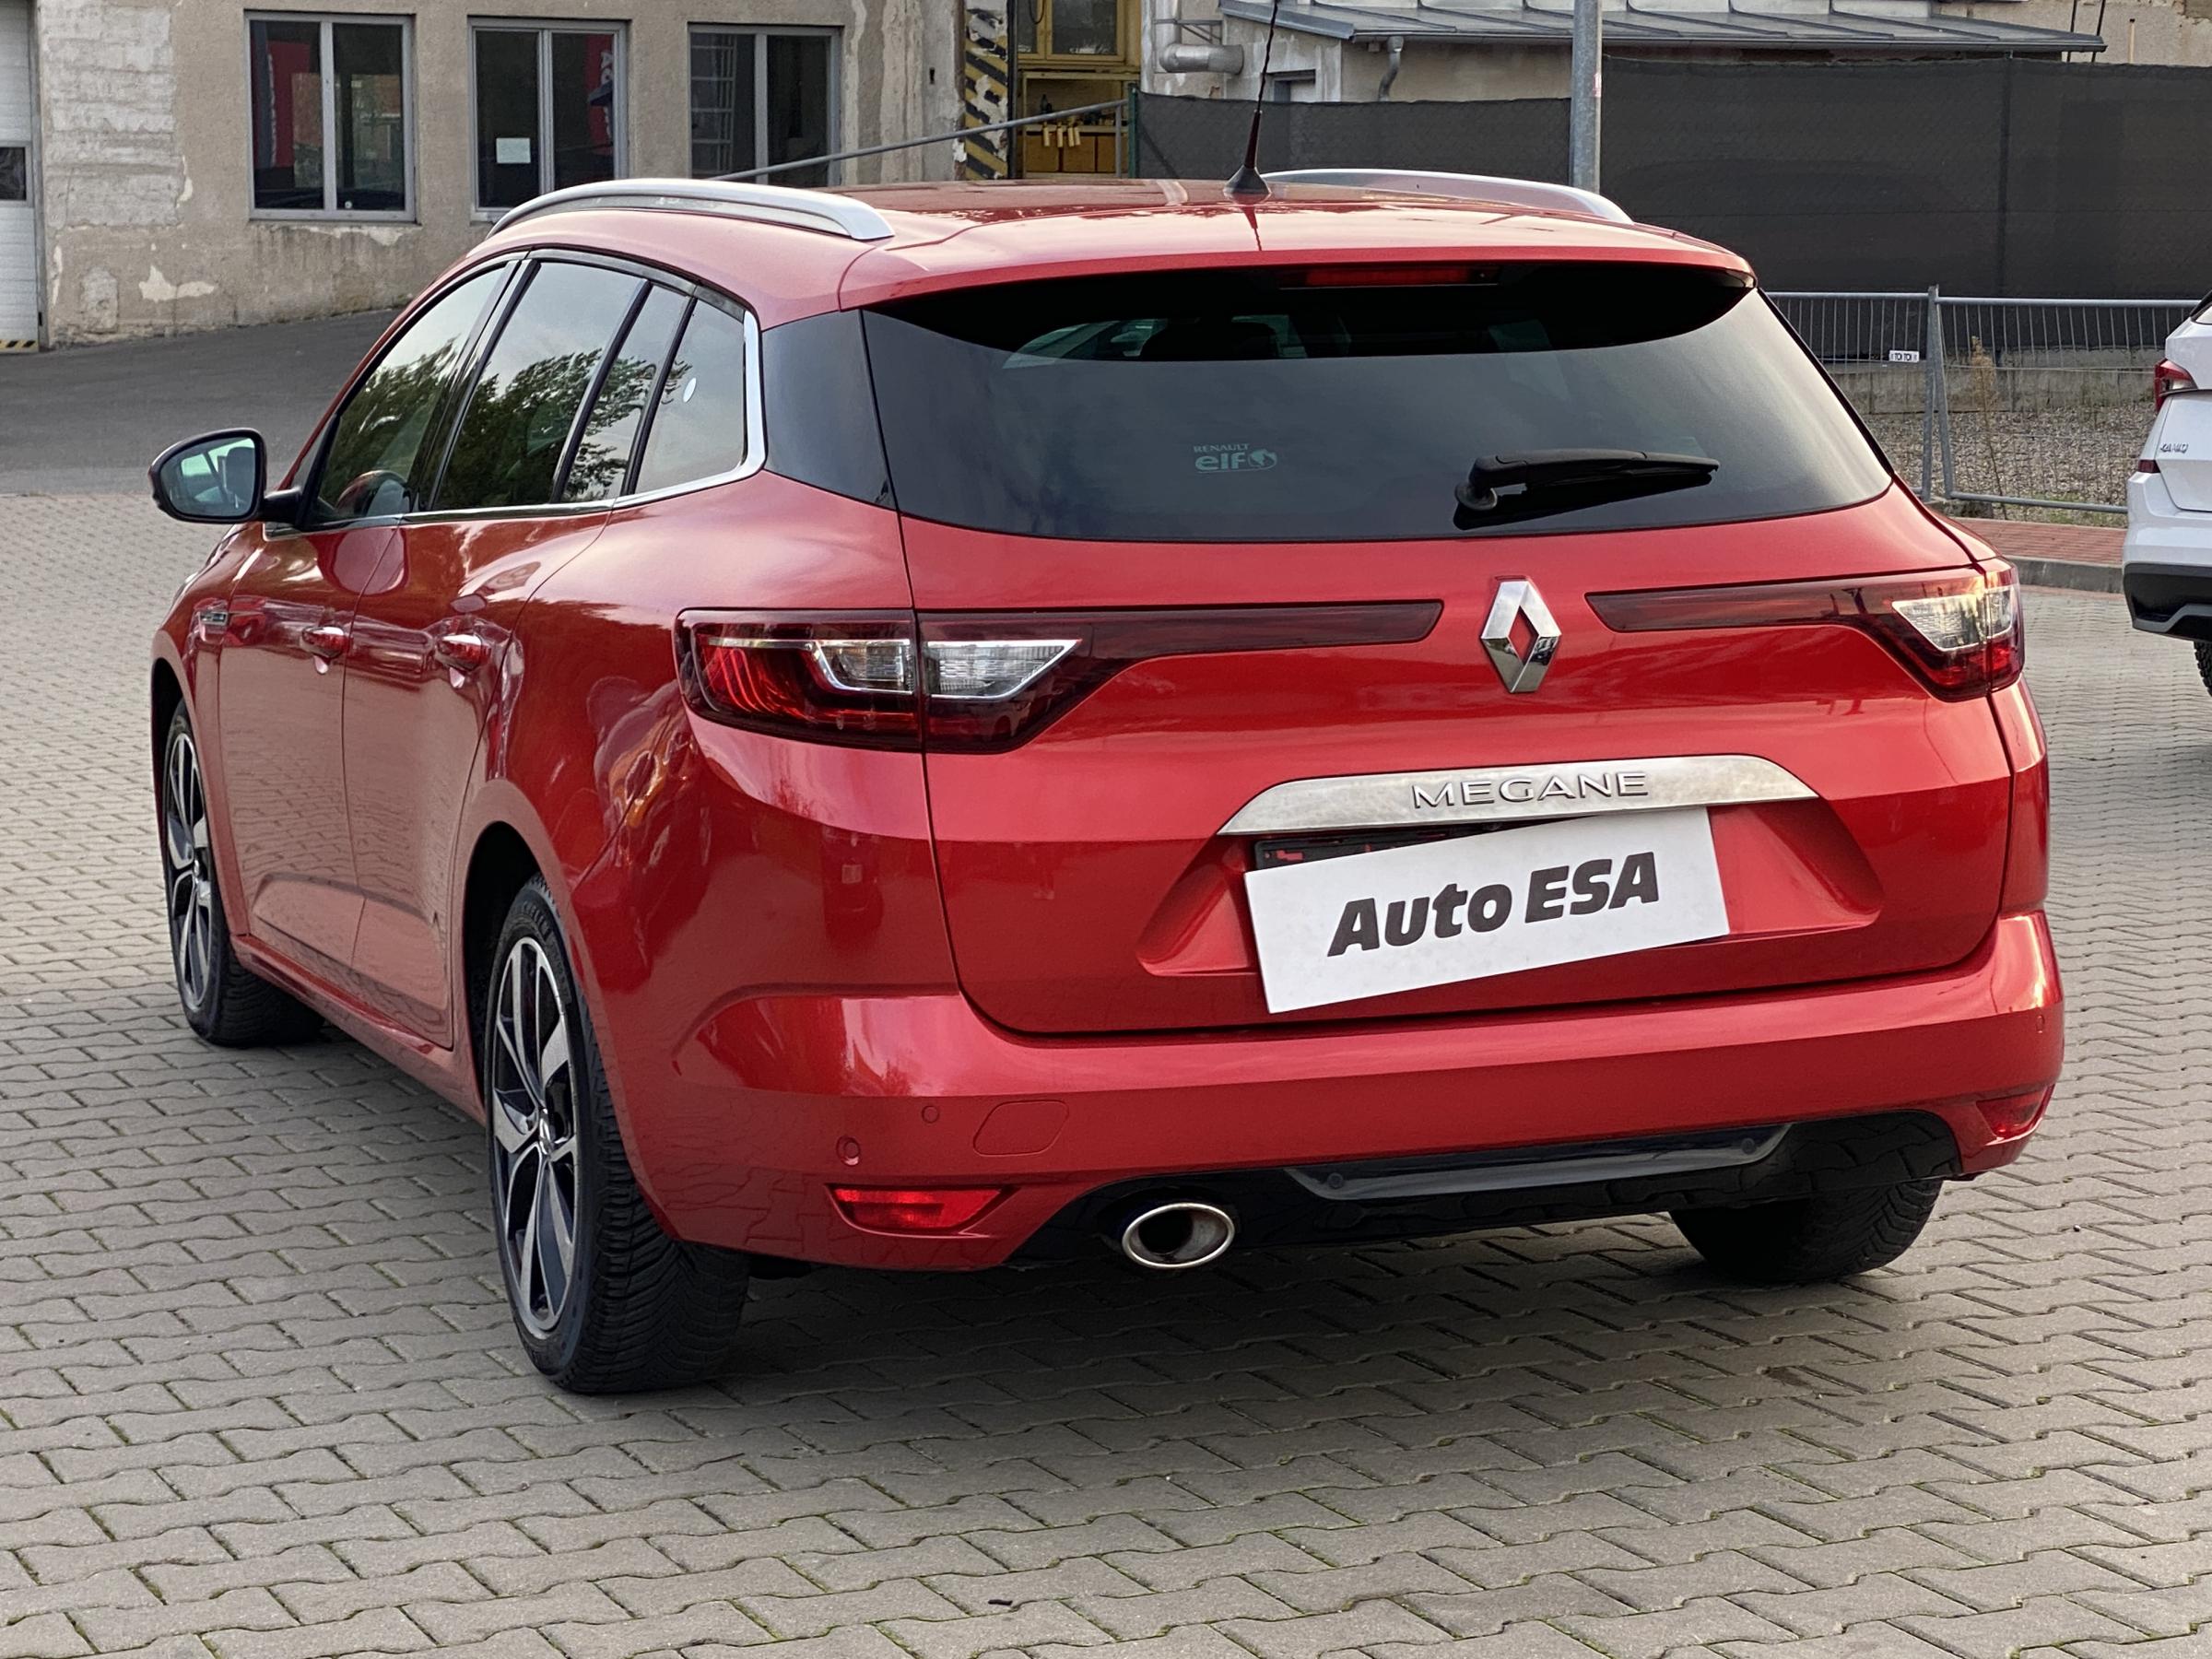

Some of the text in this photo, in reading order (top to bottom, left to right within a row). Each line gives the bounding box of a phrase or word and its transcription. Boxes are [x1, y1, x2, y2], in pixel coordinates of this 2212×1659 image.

[1194, 443, 1249, 453] RENAULT
[1194, 452, 1246, 471] elf
[1412, 772, 1649, 809] MEGANE
[1327, 851, 1659, 957] Auto ESA
